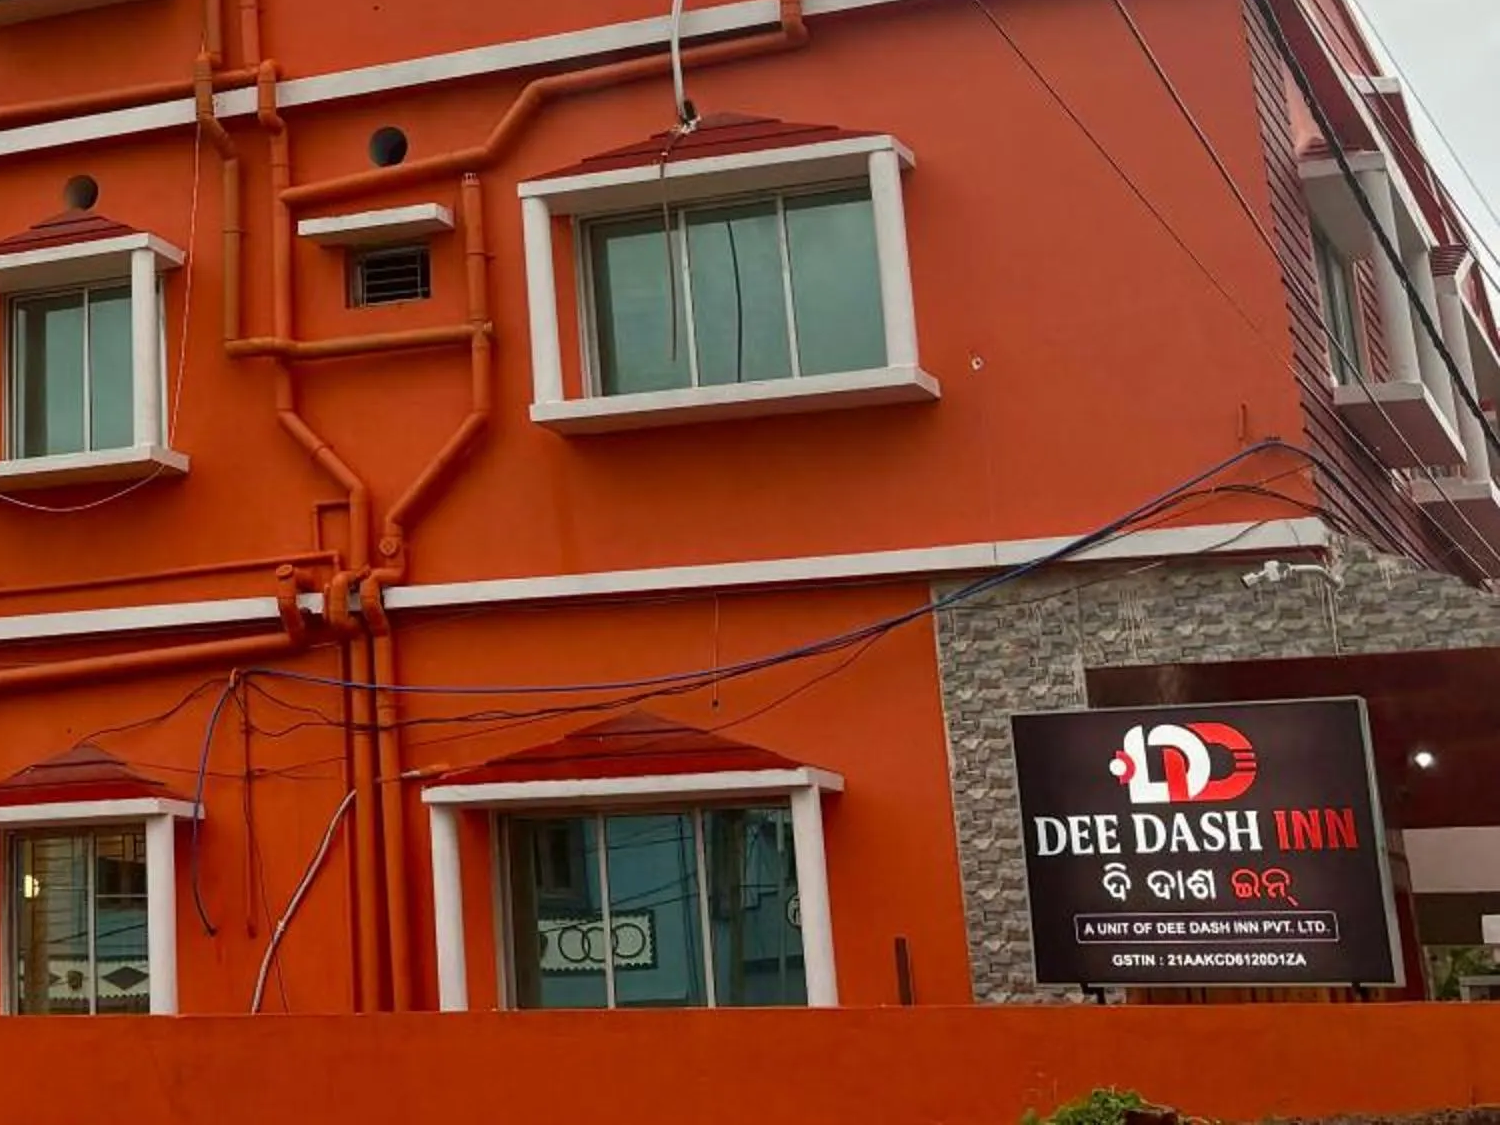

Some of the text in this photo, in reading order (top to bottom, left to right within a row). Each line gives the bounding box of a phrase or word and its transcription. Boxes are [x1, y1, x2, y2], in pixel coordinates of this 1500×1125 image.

[1034, 808, 1360, 856] DEE DASH INN
[1084, 920, 1332, 935] A UNIT OF DEE DASH INN PVT. LTD.
[1112, 954, 1156, 967] GSTIN
